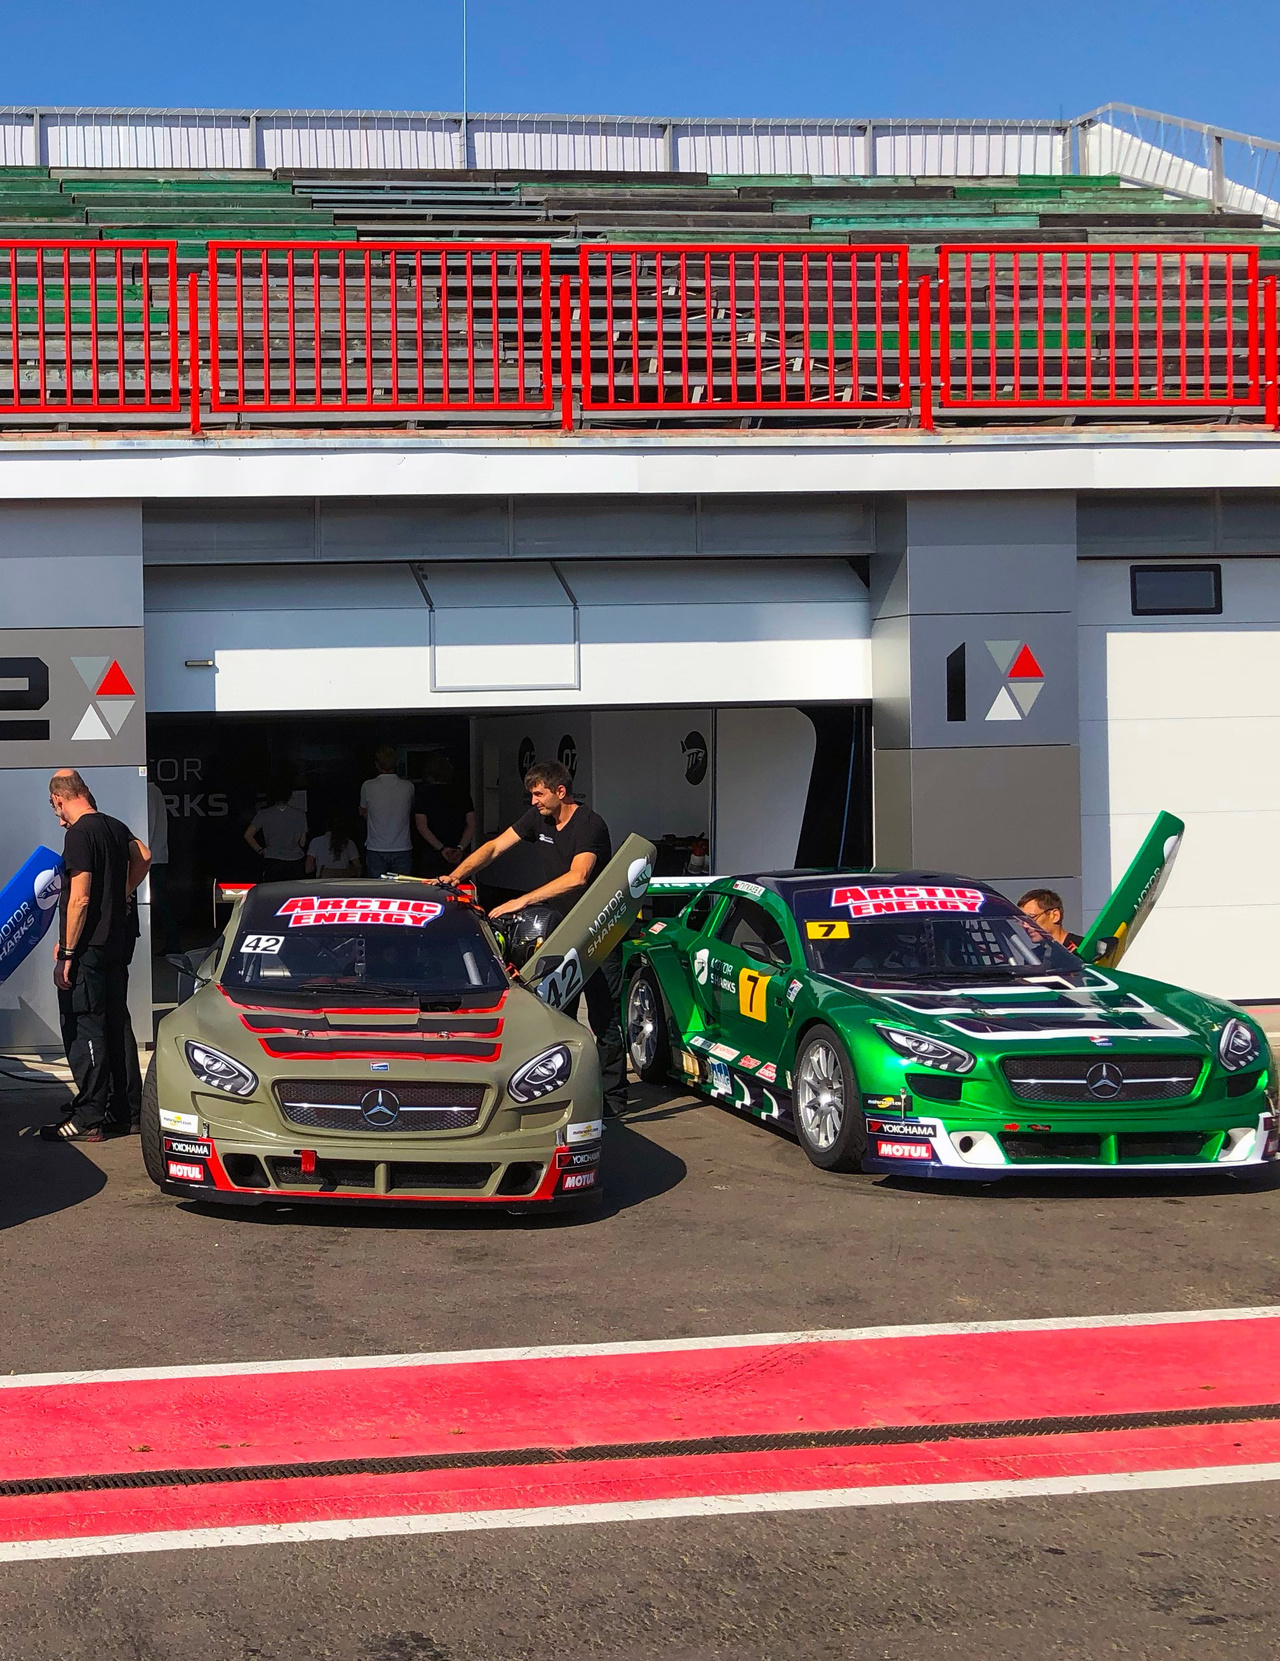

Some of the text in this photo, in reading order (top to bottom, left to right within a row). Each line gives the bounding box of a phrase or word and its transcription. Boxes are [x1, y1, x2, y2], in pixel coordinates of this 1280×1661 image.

[946, 641, 966, 722] 1
[149, 758, 203, 782] OR
[163, 793, 229, 818] RKS
[833, 886, 985, 905] ARCTIC
[277, 897, 441, 915] ARCTIC
[588, 889, 625, 936] MOTOR
[851, 900, 982, 917] ENERGY
[291, 911, 431, 927] ENERGY
[587, 902, 627, 958] SHARKS
[818, 924, 837, 937] 7
[244, 936, 281, 952] 42
[547, 958, 581, 1007] 42
[747, 974, 760, 1013] 7
[882, 1124, 934, 1136] YOKOHAMA
[171, 1142, 209, 1155] YOKOHAMA
[880, 1143, 929, 1158] MOTUL
[169, 1163, 201, 1179] MOTUL
[564, 1171, 595, 1188] MOTUL
